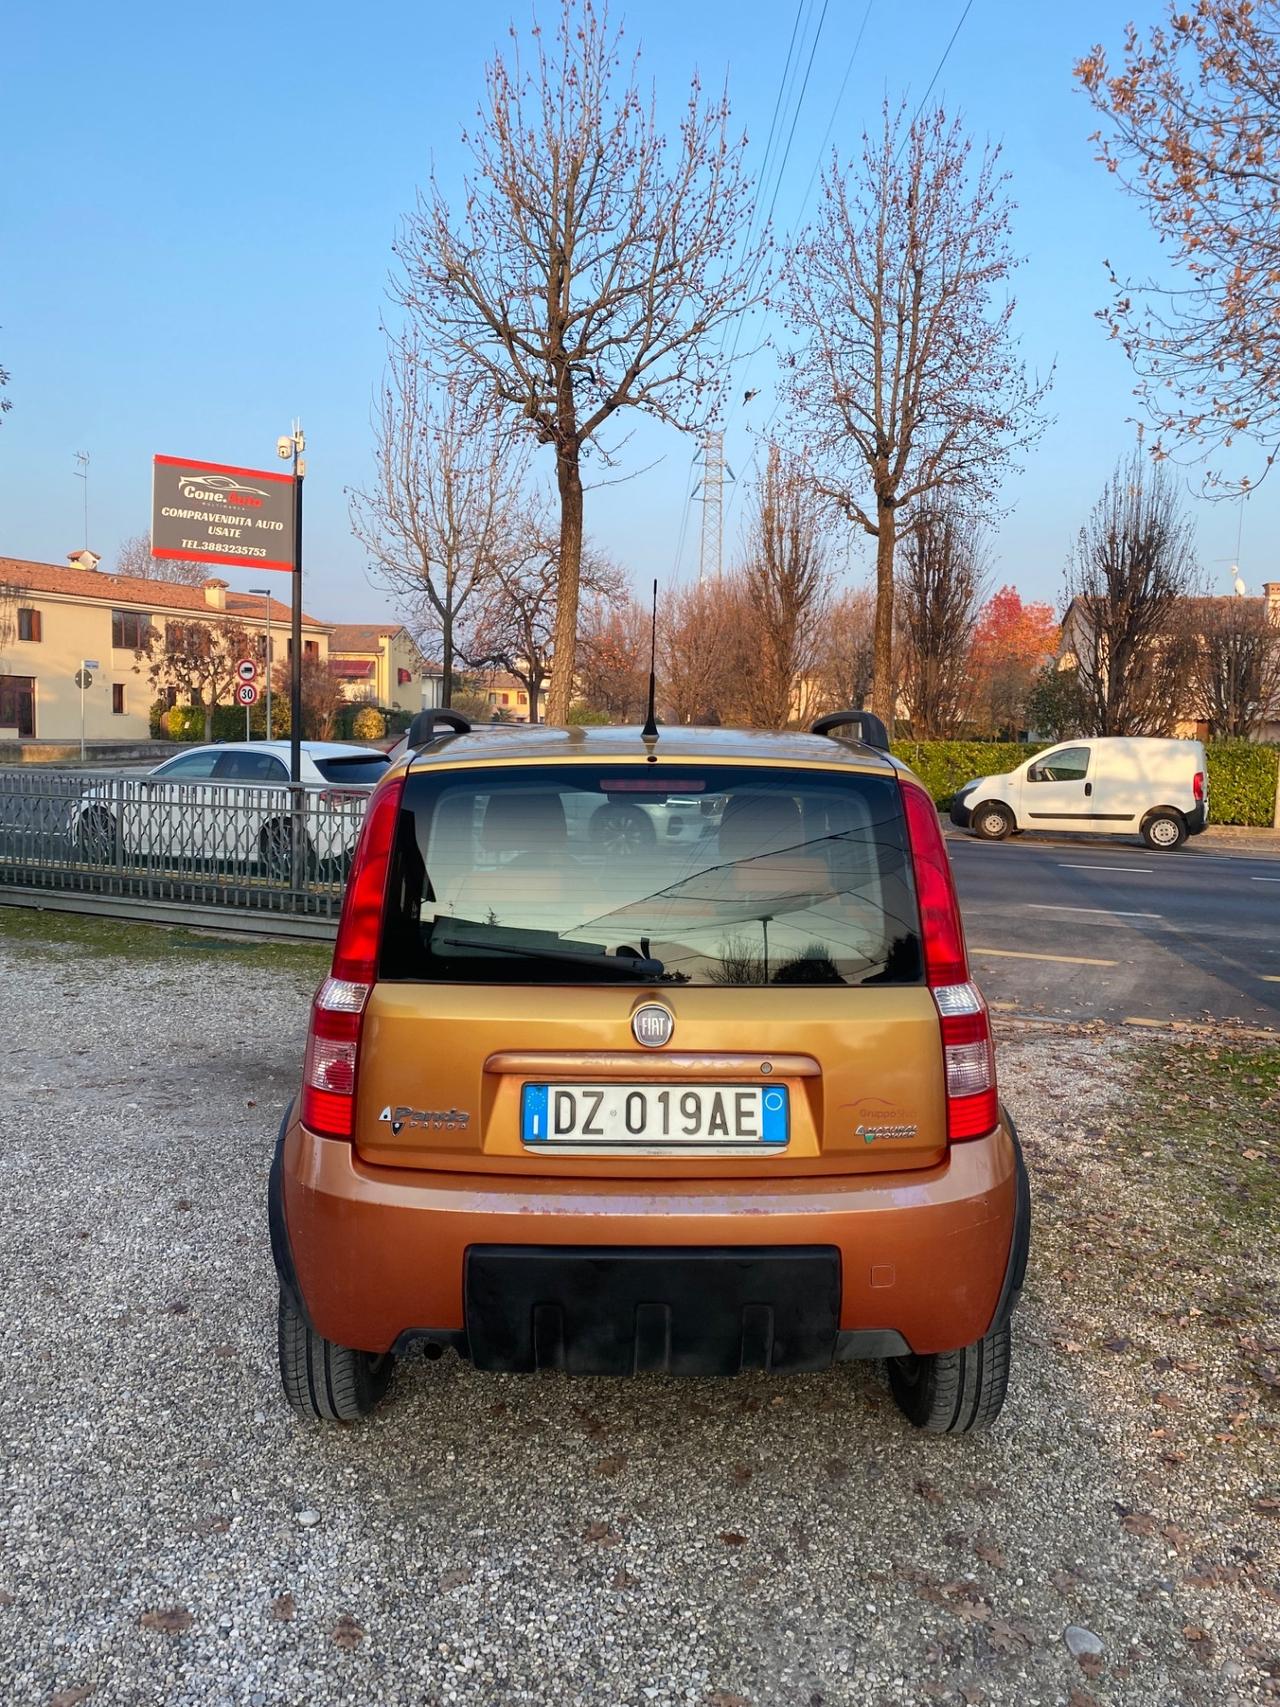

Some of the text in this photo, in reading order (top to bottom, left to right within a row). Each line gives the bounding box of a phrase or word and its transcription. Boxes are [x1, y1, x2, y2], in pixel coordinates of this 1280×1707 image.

[161, 506, 284, 531] COMPRAVENDITA AUTO
[208, 526, 242, 538] USATE
[241, 689, 253, 699] 30
[641, 1017, 665, 1036] FIAT
[395, 1106, 470, 1121] Panda
[554, 1090, 757, 1136] DZ 019AE
